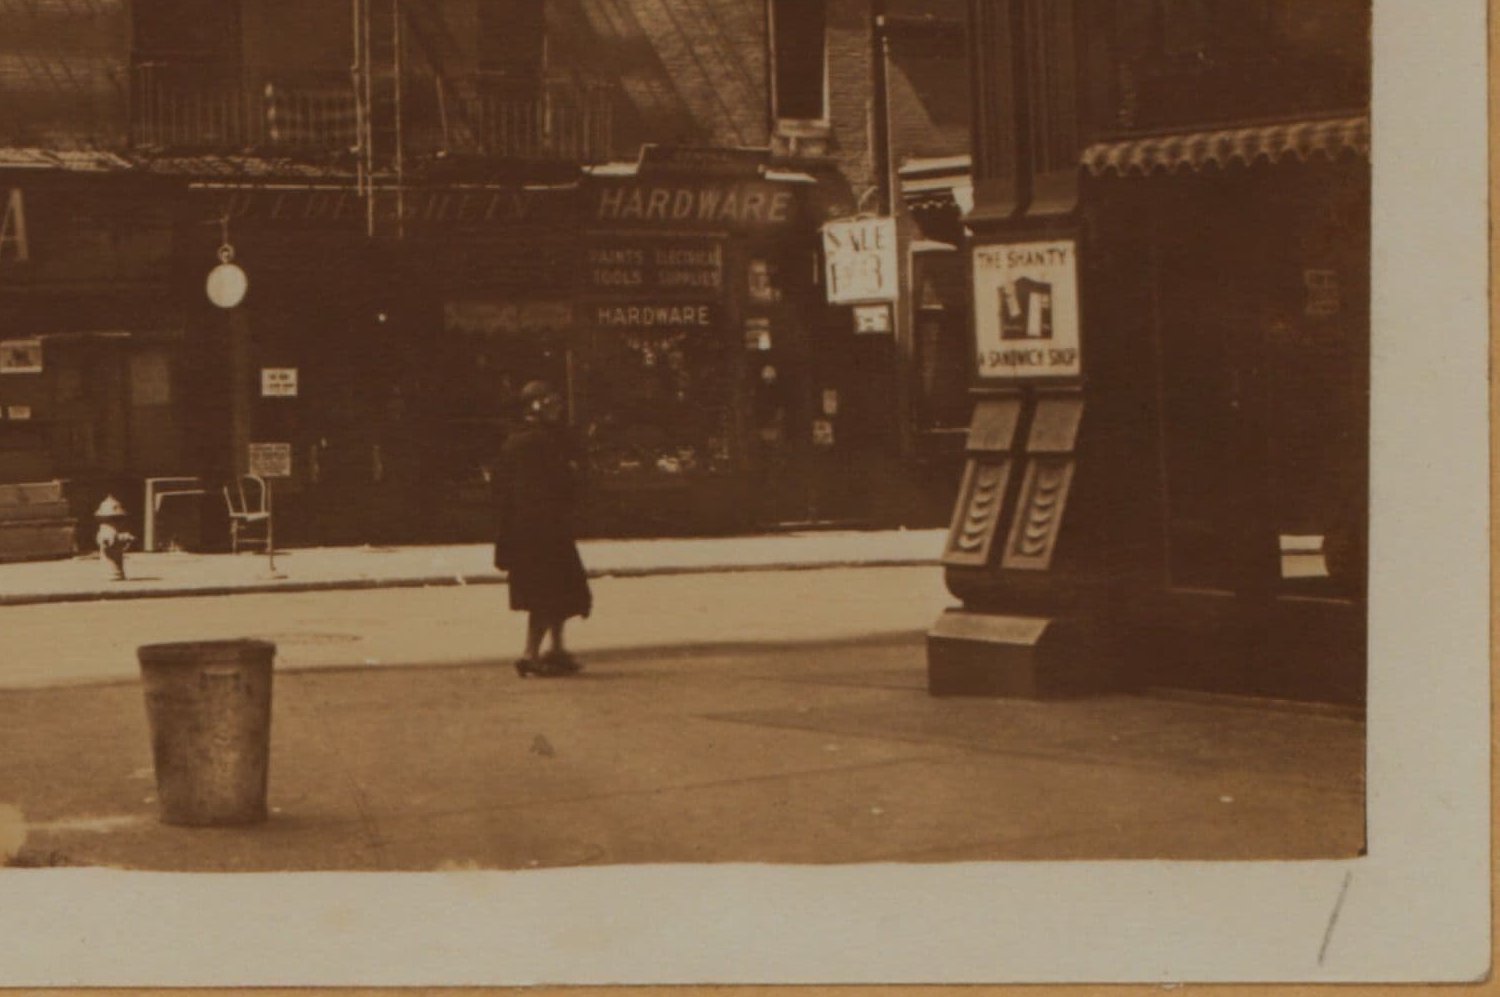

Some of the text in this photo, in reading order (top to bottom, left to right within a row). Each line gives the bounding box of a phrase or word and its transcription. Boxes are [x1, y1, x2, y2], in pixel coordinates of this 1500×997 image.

[599, 188, 792, 222] HARDWARE
[977, 248, 1068, 270] THE SHANTY
[598, 307, 711, 325] HARDWARE
